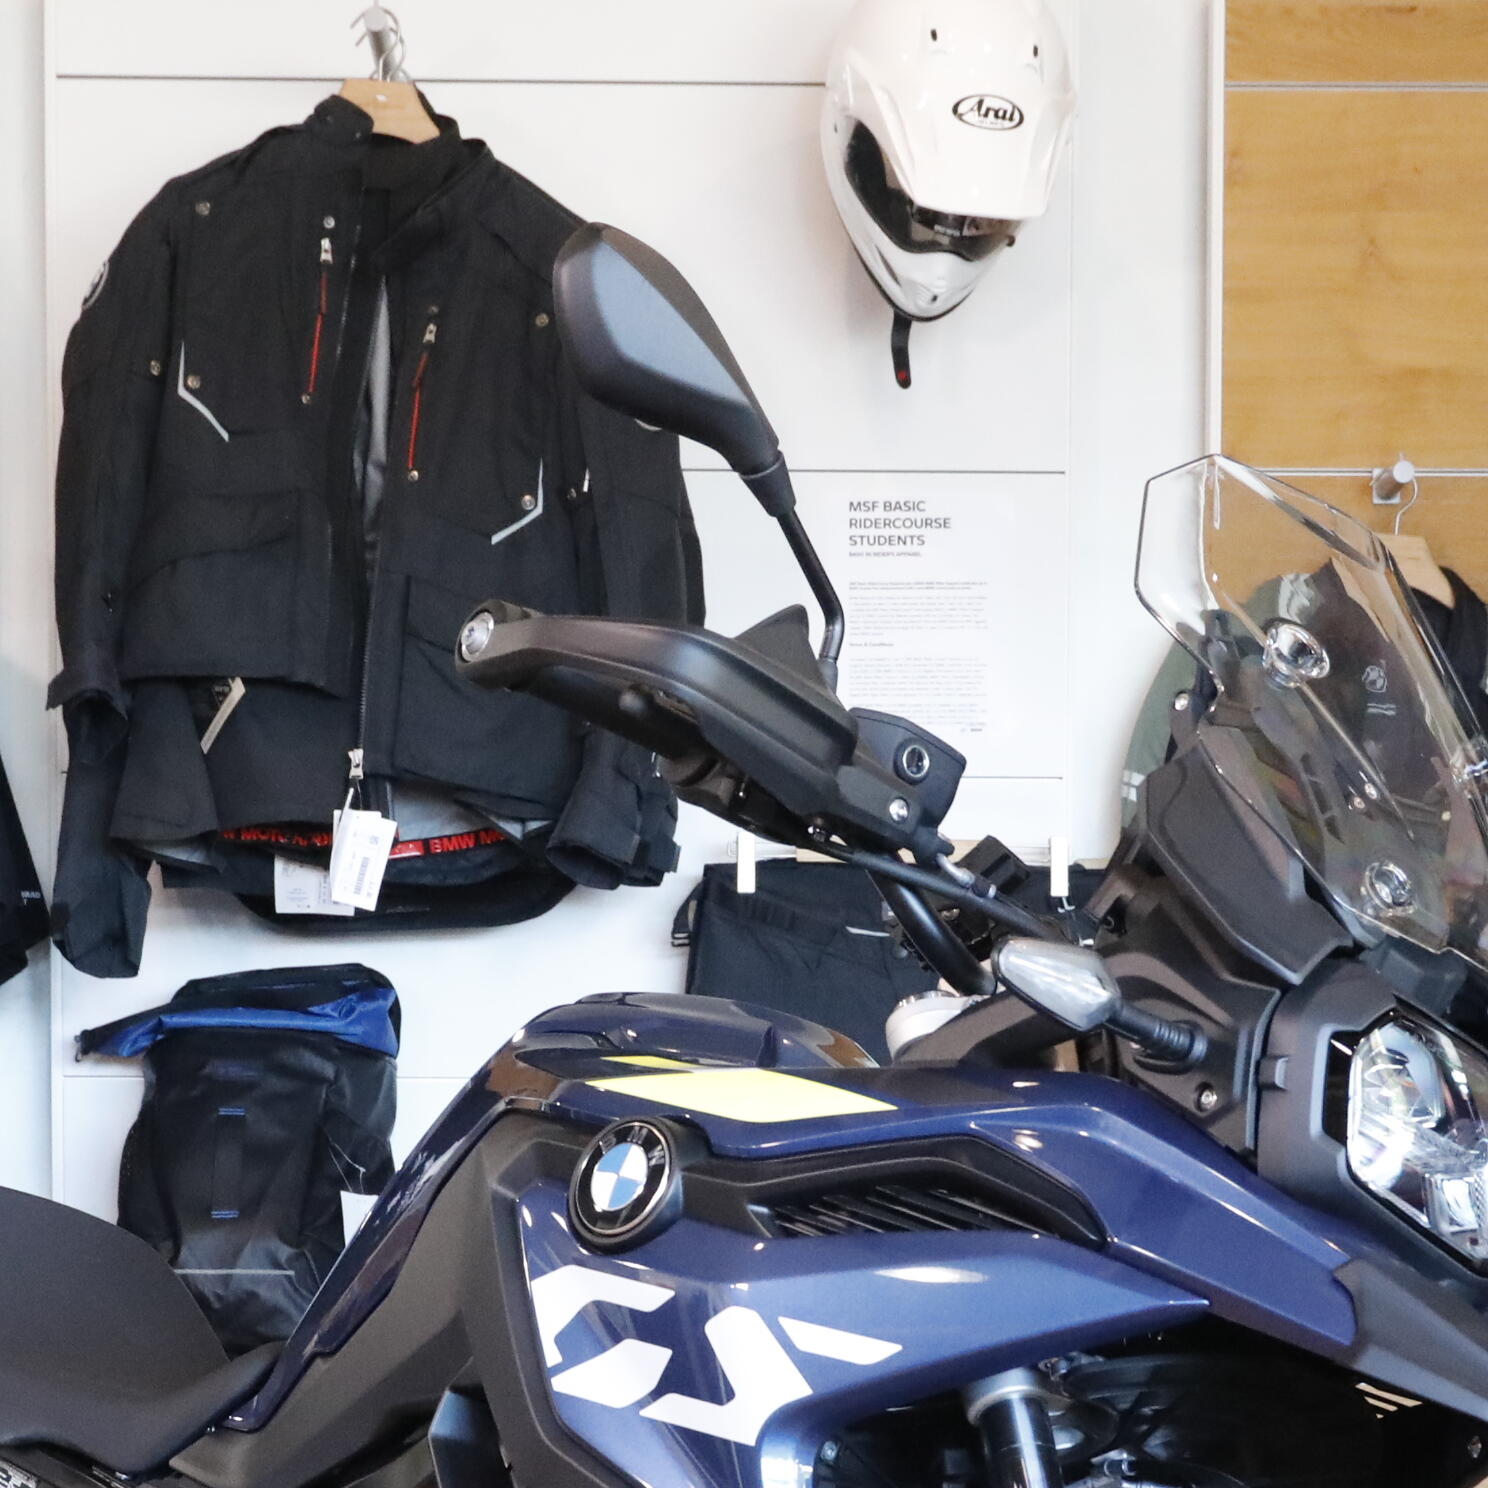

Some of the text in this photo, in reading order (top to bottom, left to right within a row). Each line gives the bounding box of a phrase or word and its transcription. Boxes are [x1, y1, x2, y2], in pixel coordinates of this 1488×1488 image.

[960, 97, 1016, 122] Arai
[848, 500, 926, 512] MSF BASIC
[848, 517, 952, 530] RIDERCOURSE
[848, 534, 926, 546] STUDENTS
[429, 834, 476, 854] BMW
